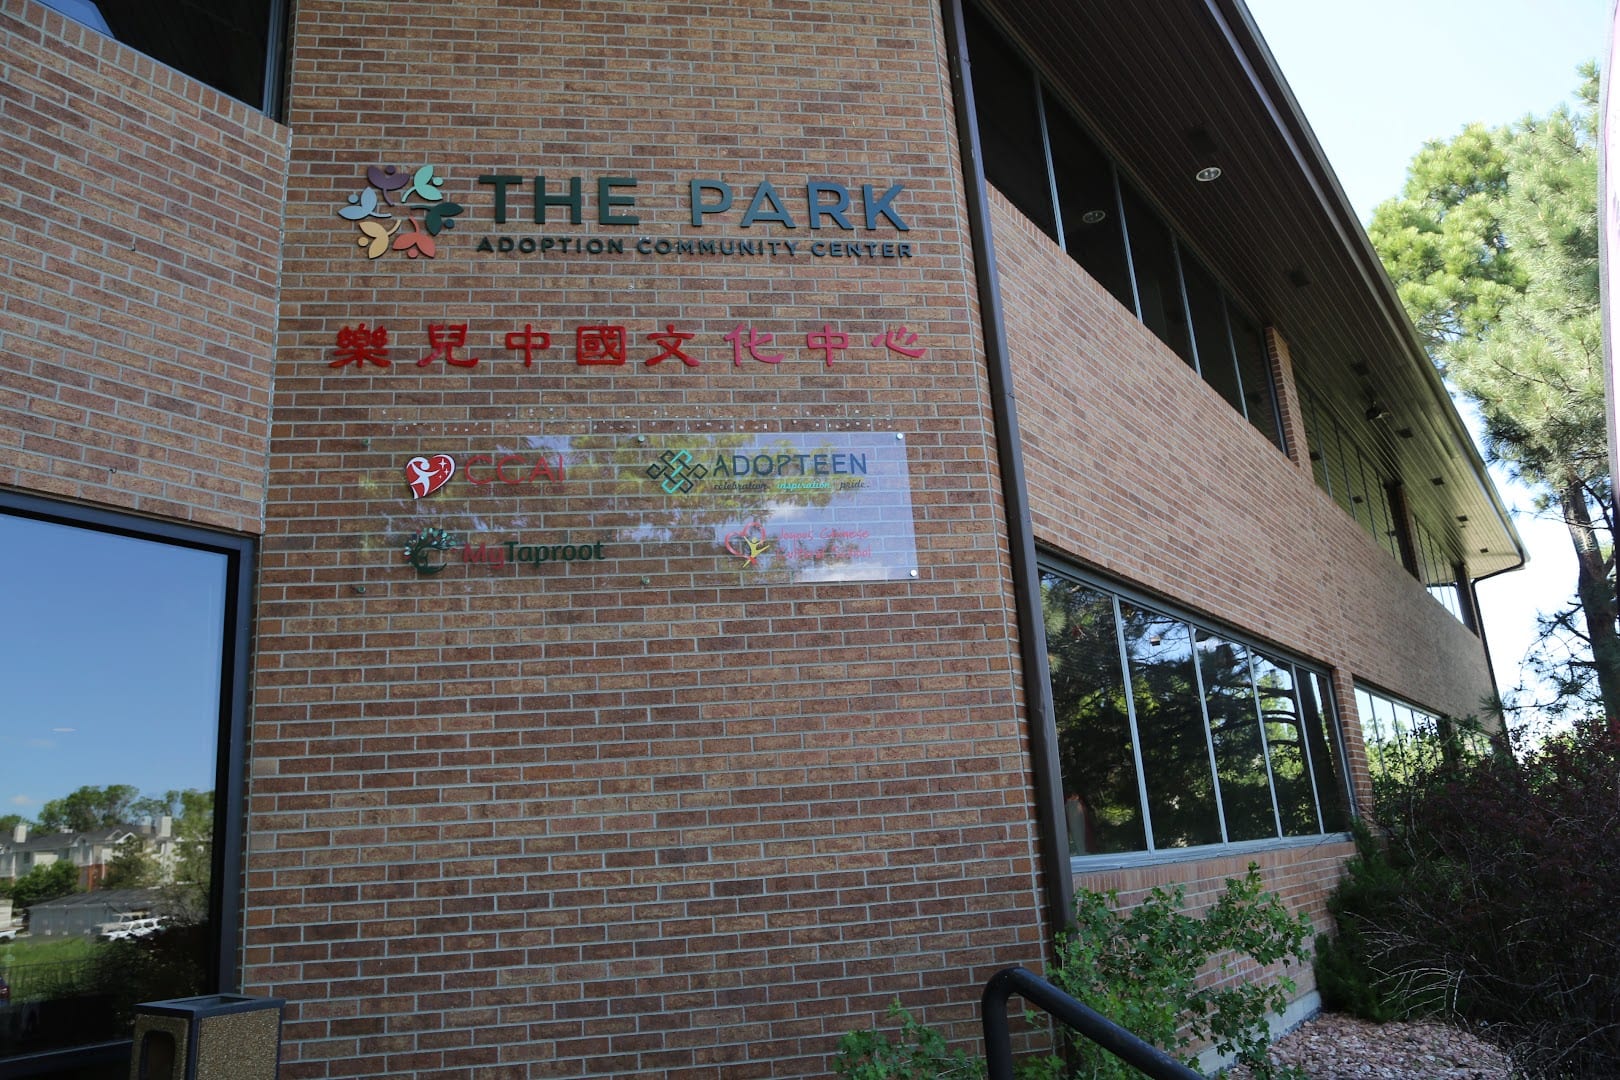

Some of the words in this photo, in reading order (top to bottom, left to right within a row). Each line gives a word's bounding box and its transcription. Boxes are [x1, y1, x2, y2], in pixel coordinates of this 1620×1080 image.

[479, 175, 640, 226] THE
[690, 179, 910, 231] PARK
[476, 236, 625, 254] ADOPTION
[637, 237, 799, 257] COMMUNITY
[811, 241, 913, 258] CENTER
[333, 322, 928, 369] 樂兒中國文化中心
[464, 454, 564, 485] CCAI
[713, 452, 867, 477] ADOPTEEN
[463, 540, 606, 570] MyTaproot
